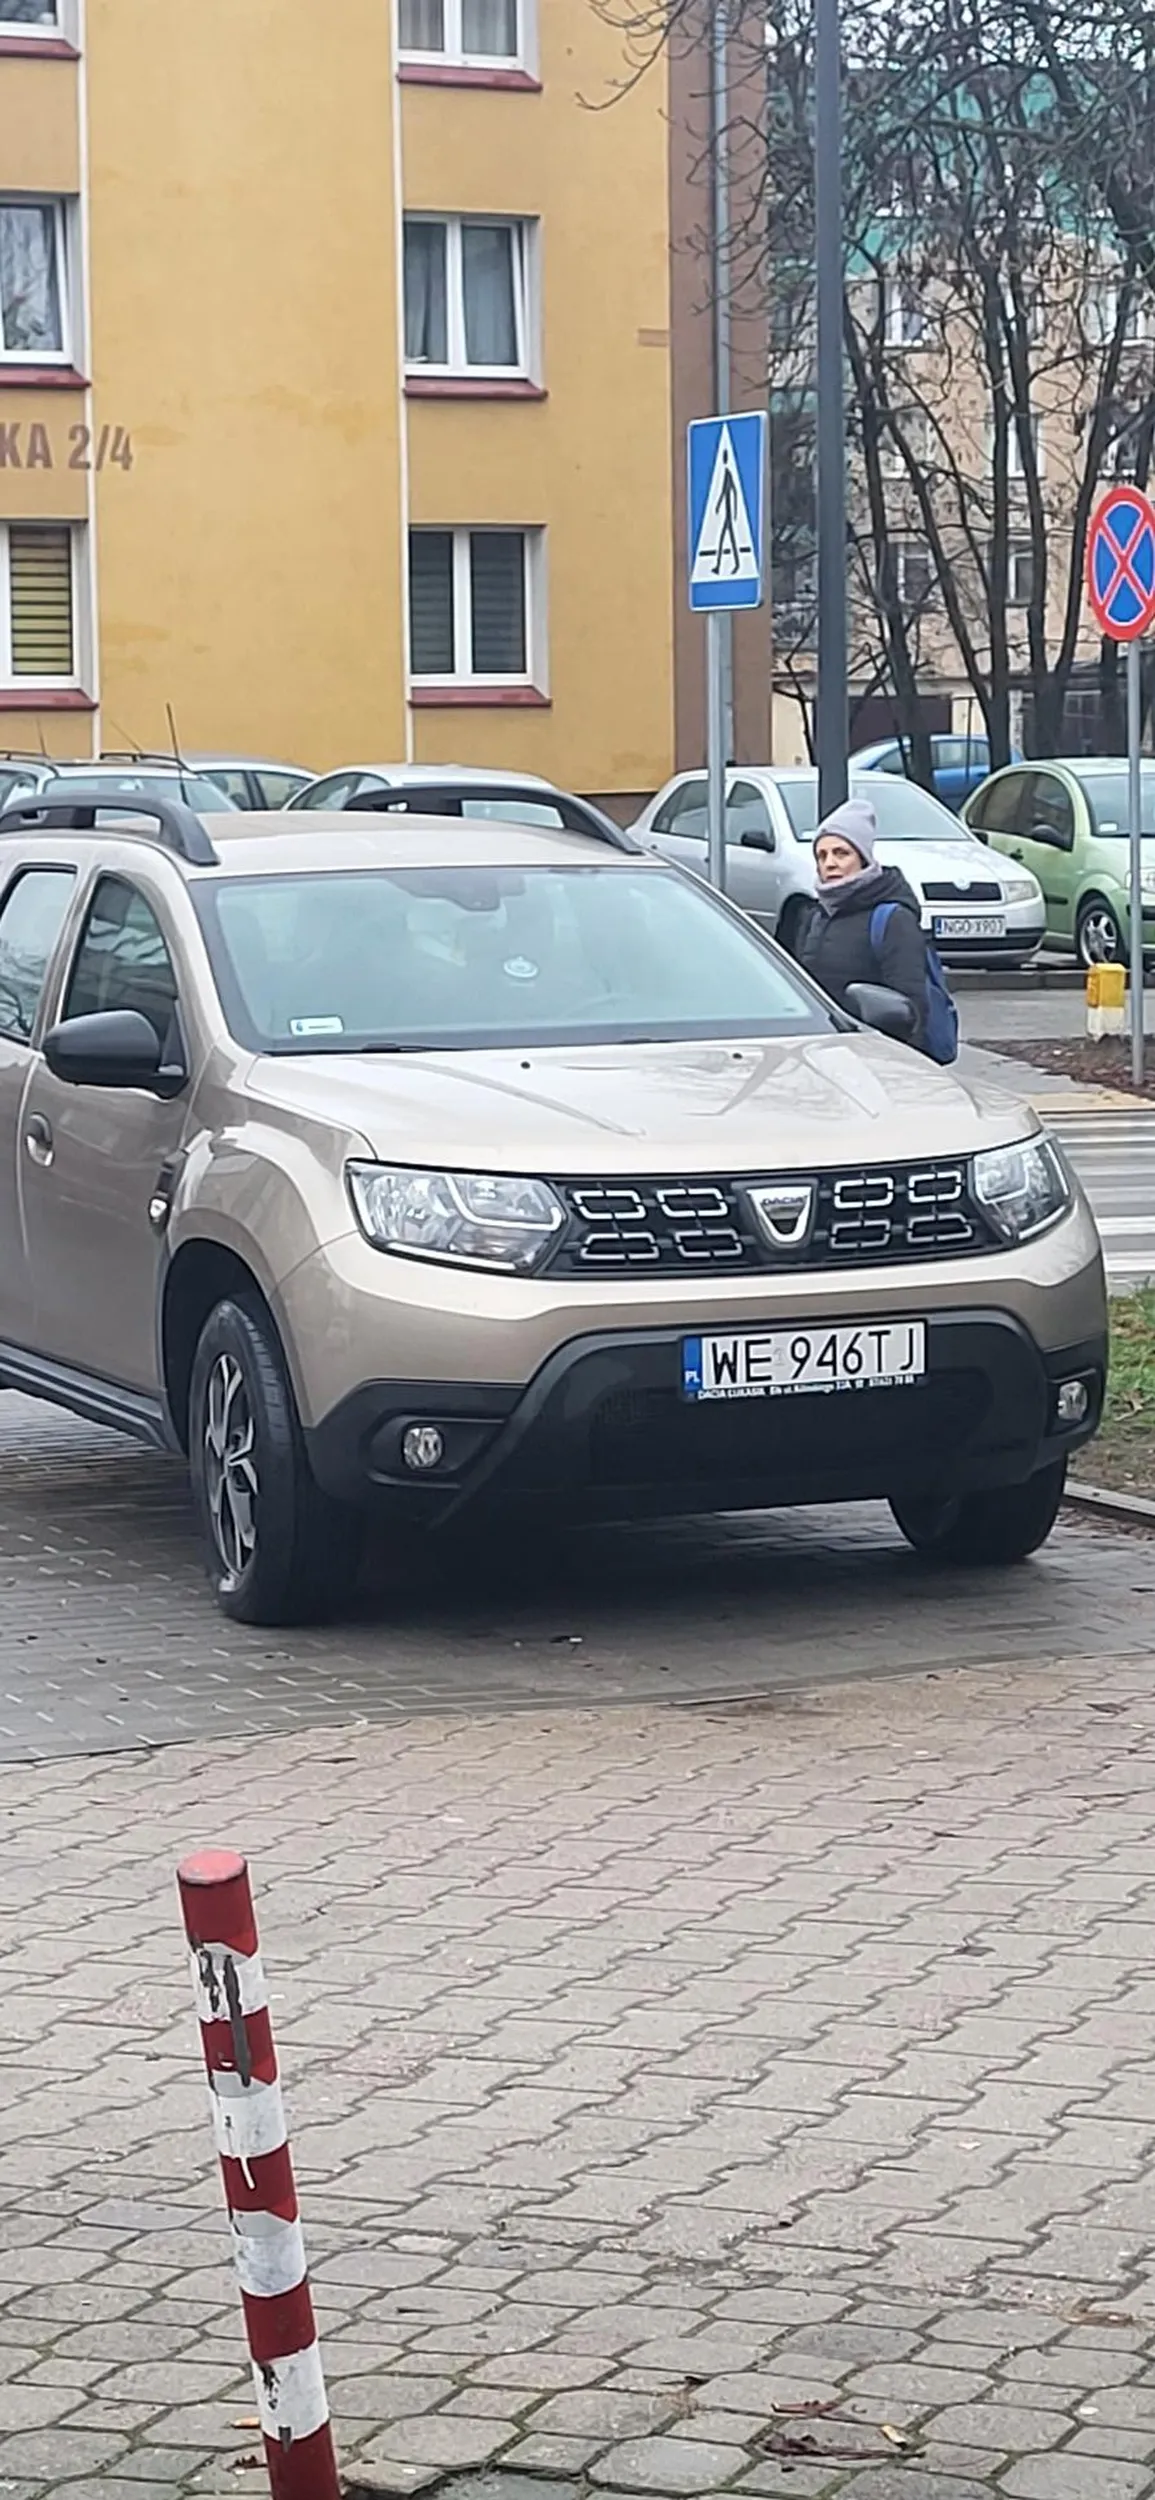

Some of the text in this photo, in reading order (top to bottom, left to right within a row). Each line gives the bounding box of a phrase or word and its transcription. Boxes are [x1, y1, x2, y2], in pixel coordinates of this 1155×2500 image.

[0, 422, 133, 471] KA 2/4
[684, 1370, 700, 1384] PL
[712, 1328, 915, 1385] WE 946TJ
